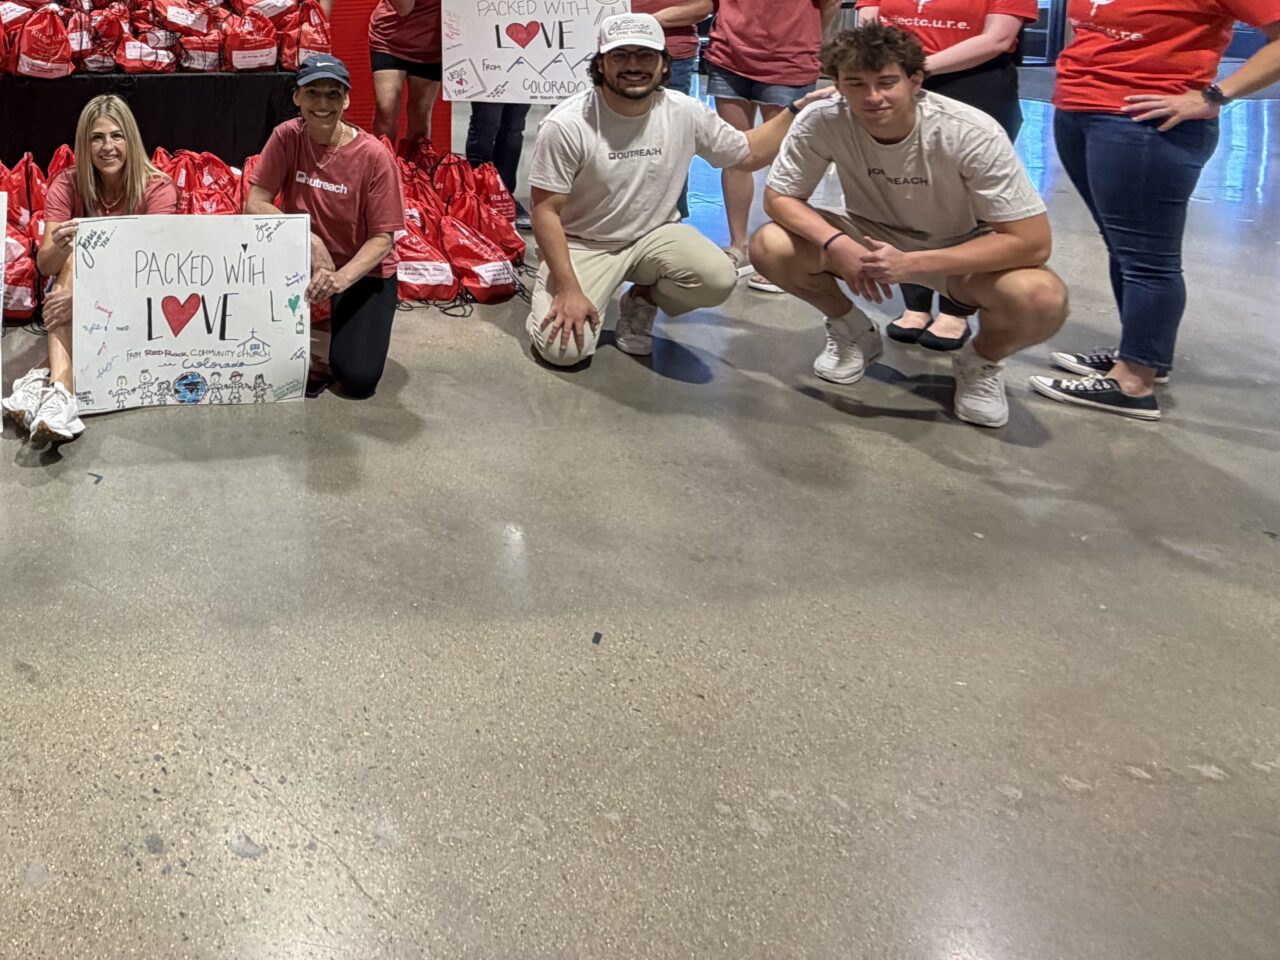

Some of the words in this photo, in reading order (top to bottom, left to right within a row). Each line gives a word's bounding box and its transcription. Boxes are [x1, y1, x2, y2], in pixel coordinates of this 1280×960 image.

[477, 0, 537, 17] PACKED
[523, 78, 587, 94] COLORADO
[617, 148, 662, 159] OUTREACH
[305, 176, 348, 195] outreach
[135, 249, 214, 288] PACKED
[223, 251, 265, 286] WITH
[144, 349, 164, 357] RED
[190, 349, 235, 358] COMMUNITY
[182, 358, 248, 369] Colorado
